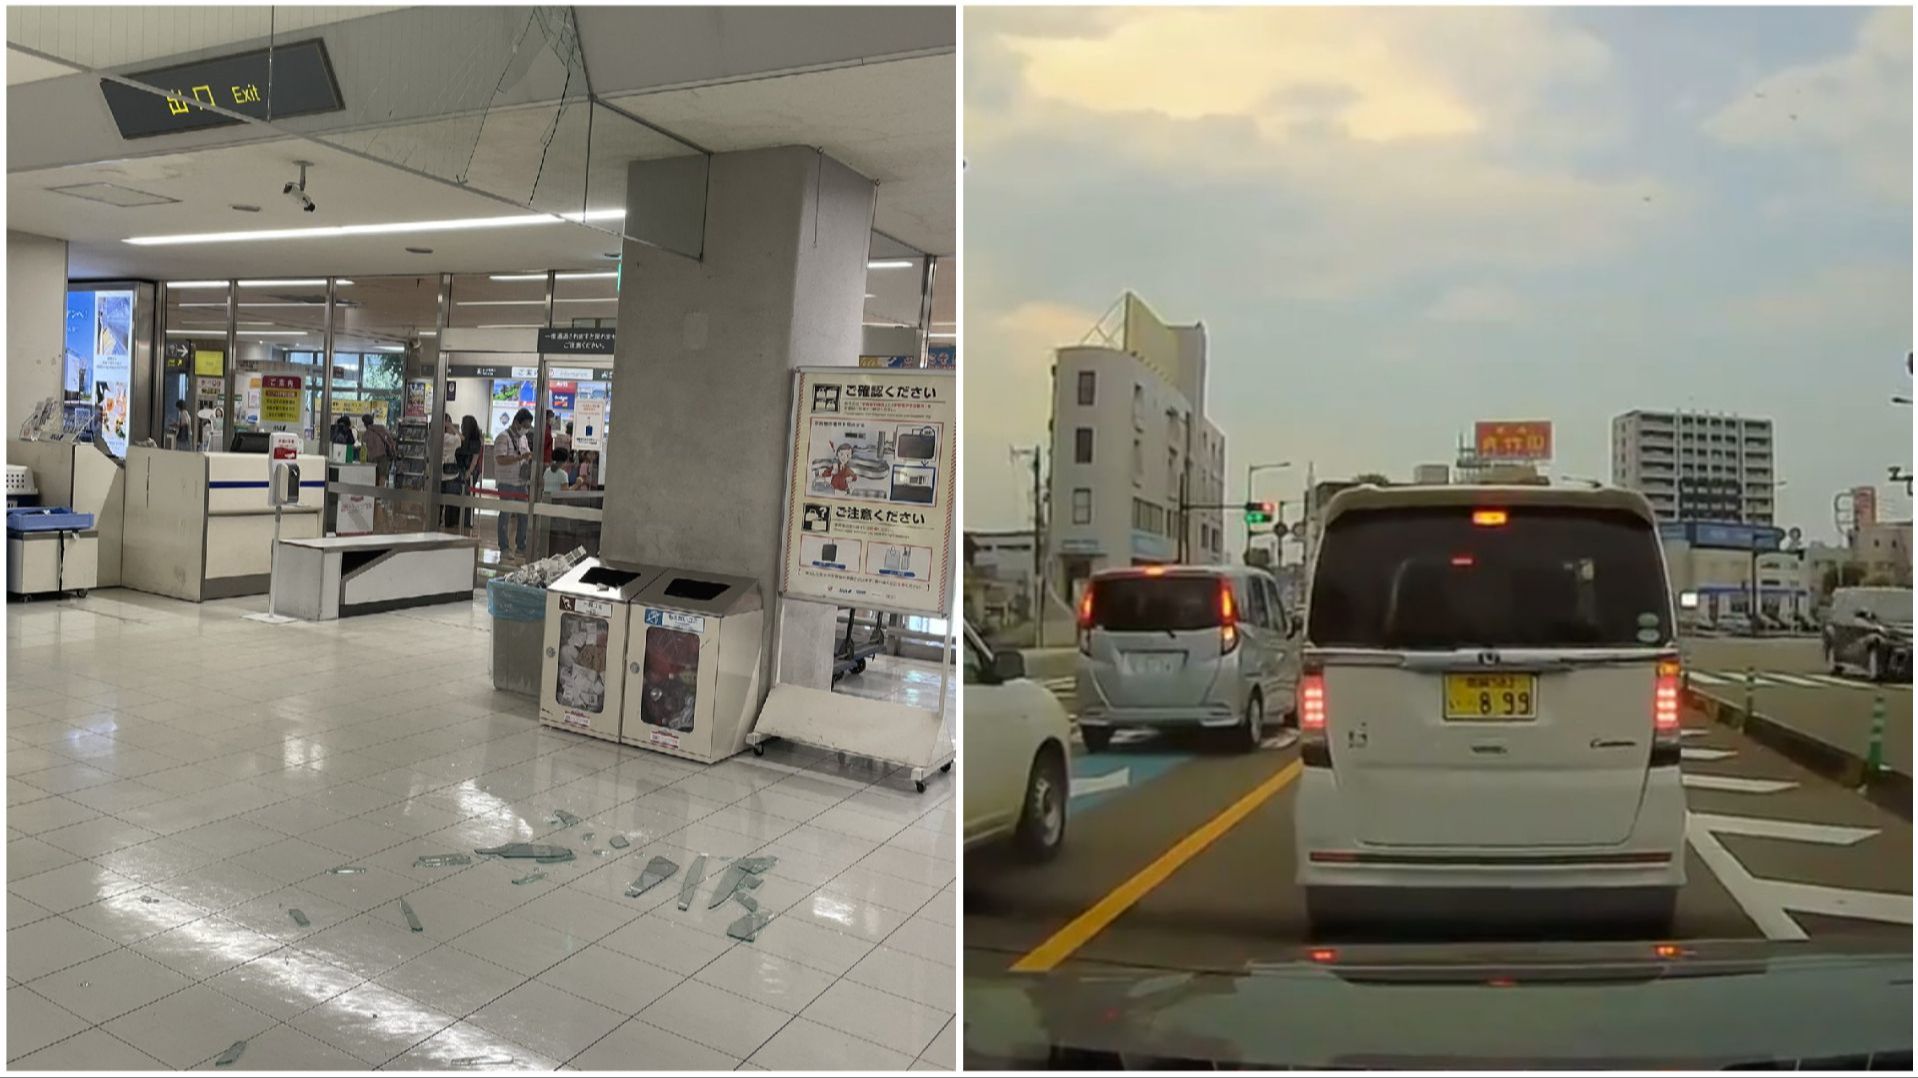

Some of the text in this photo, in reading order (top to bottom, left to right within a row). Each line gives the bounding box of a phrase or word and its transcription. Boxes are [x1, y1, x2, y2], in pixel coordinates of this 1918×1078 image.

[166, 83, 261, 116] 出口 Exit
[846, 384, 937, 399] ご確認ください
[836, 506, 925, 524] ご注意ください
